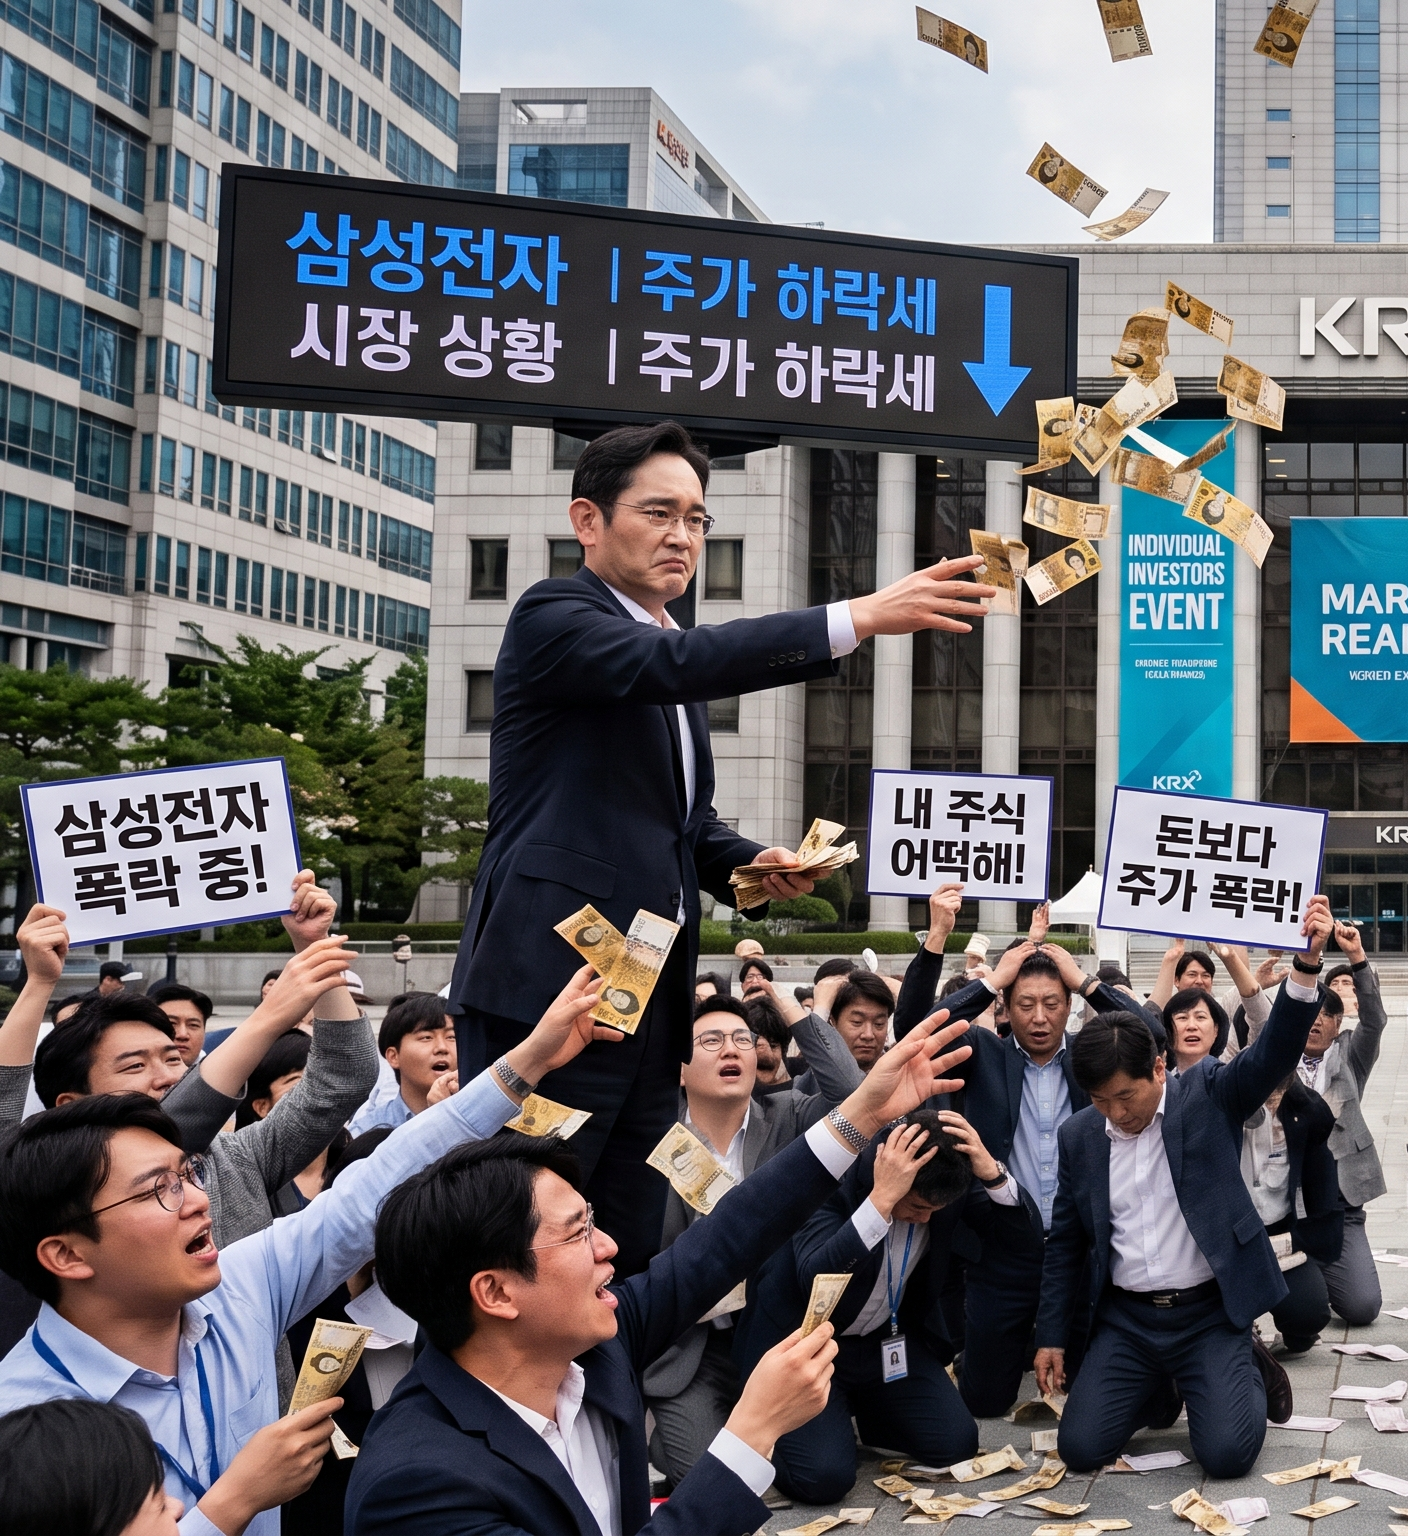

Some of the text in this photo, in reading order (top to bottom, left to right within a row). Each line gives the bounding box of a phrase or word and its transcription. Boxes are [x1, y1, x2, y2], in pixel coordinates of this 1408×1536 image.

[286, 212, 568, 305] 삼성전자
[642, 251, 756, 318] 주가
[778, 264, 936, 335] 하락세
[291, 303, 418, 371] 시장
[440, 315, 562, 383] 상황
[640, 331, 754, 397] 주가
[776, 342, 934, 412] 하락세
[1128, 534, 1225, 556] INDIVIDUAL
[1128, 562, 1225, 585] INVESTORS
[1130, 592, 1225, 630] EVENT
[1153, 775, 1196, 790] KRX
[55, 782, 269, 858] 삼성전자
[895, 788, 1025, 835] 내 주식
[892, 839, 1025, 884] 어떡해!
[1156, 815, 1276, 868] 돈보다
[74, 844, 267, 915] 폭락 중!
[1118, 863, 1302, 923] 주가 폭락!
